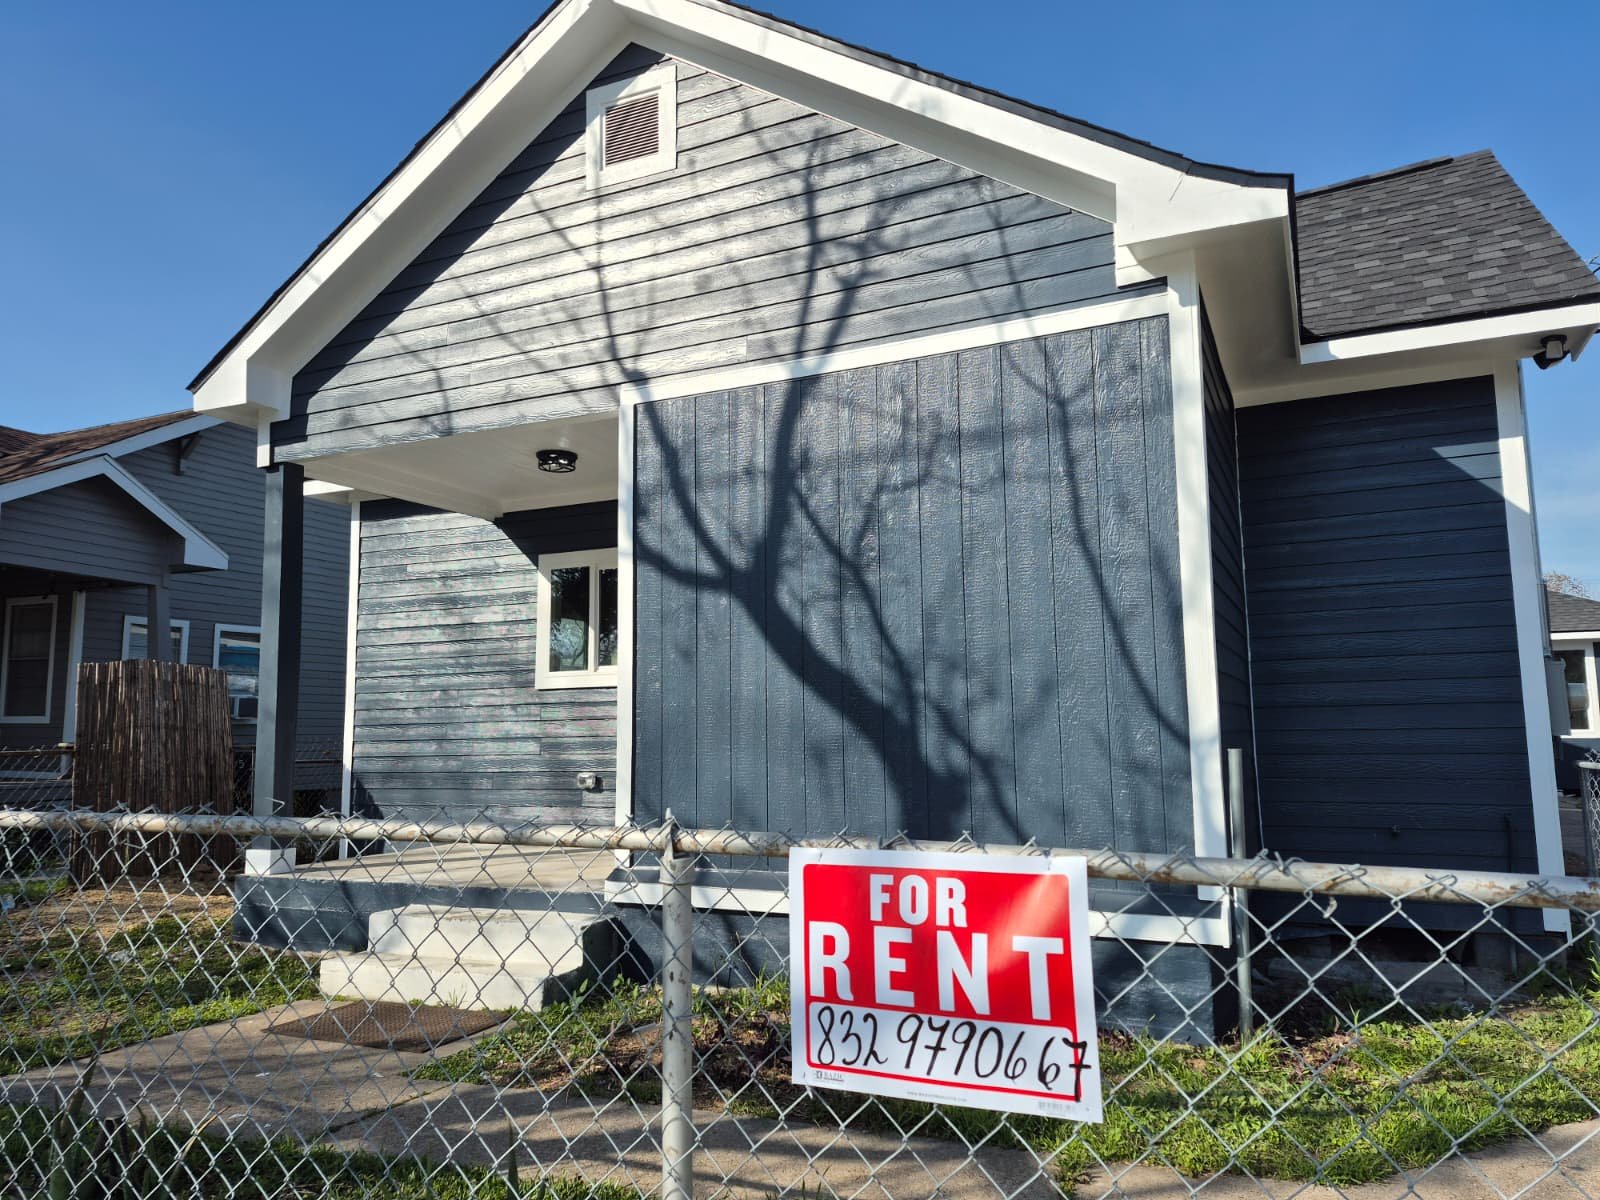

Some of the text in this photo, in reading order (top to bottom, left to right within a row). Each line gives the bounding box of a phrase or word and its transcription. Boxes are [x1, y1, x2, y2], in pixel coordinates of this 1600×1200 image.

[869, 873, 967, 928] FOR
[808, 920, 1065, 1021] RENT
[817, 1005, 888, 1067] 832
